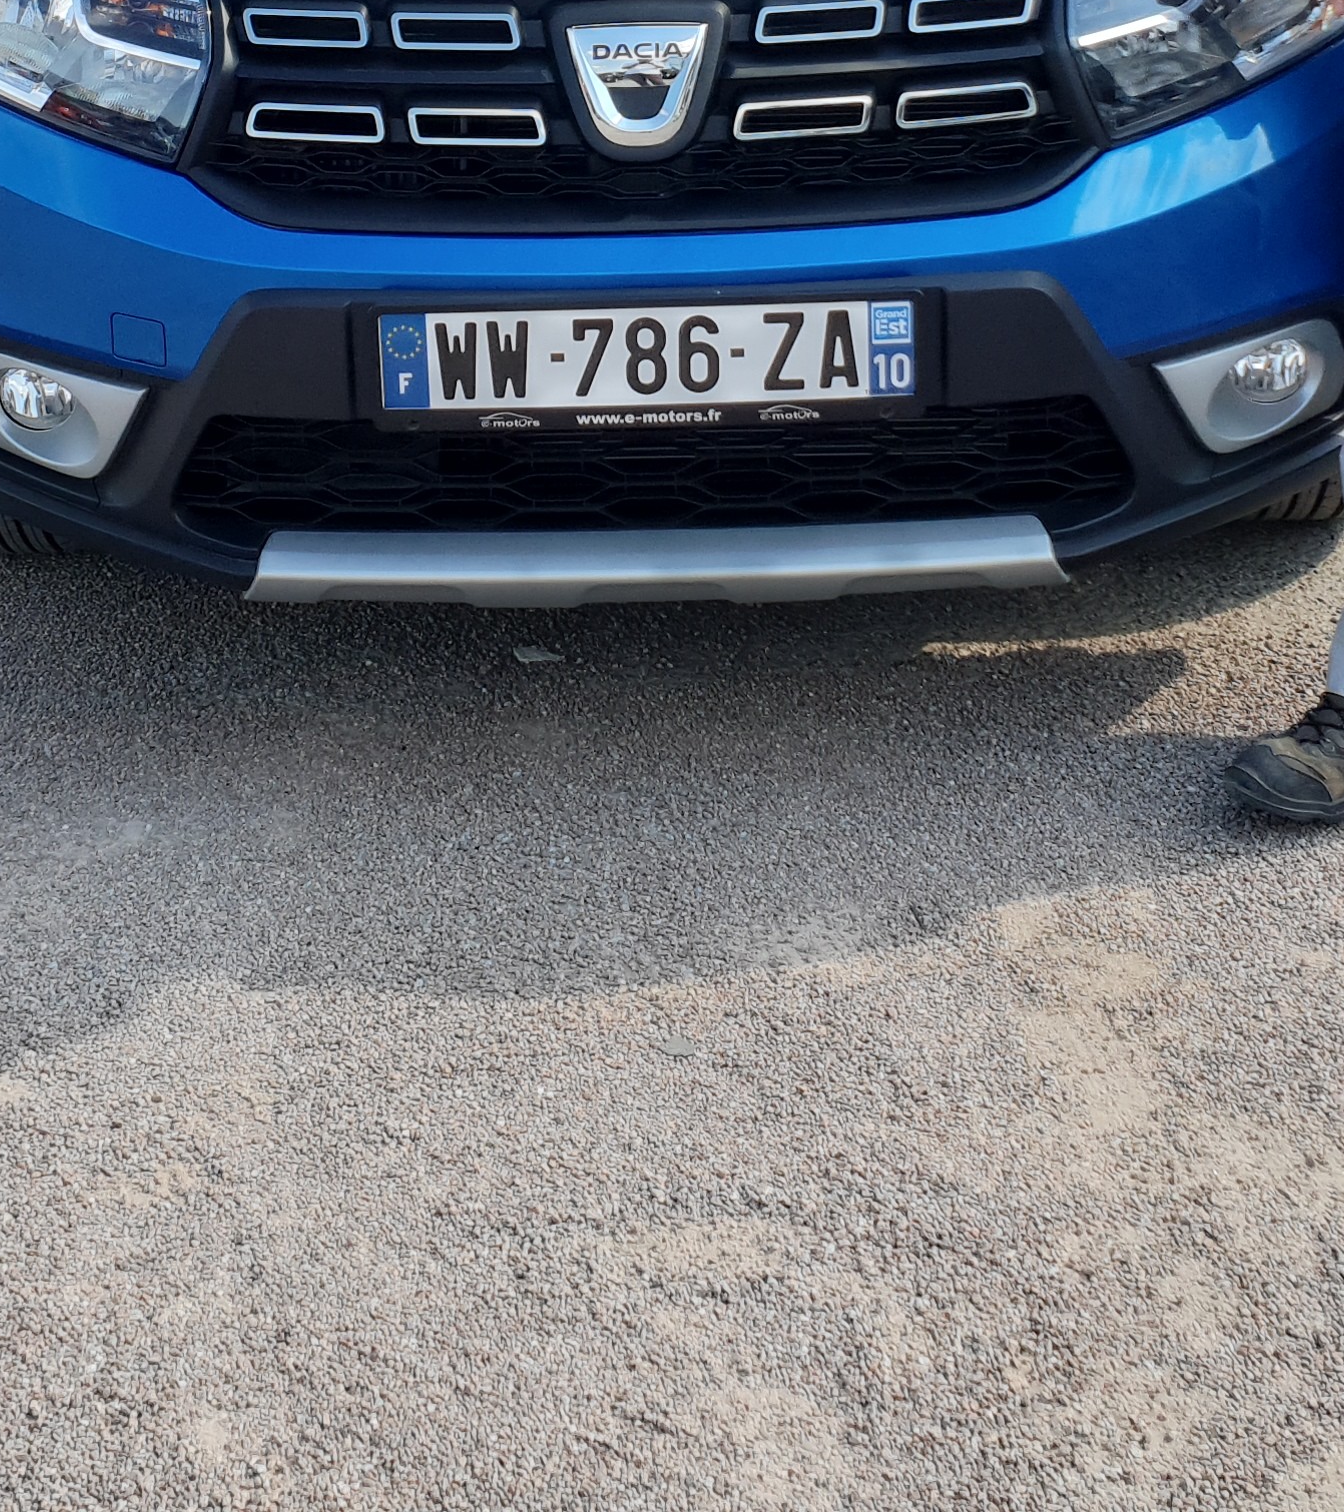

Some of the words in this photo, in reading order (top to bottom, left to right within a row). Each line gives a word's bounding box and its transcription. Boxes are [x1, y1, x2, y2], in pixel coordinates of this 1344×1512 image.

[592, 42, 683, 60] DACIA
[875, 308, 907, 319] Grand
[875, 318, 908, 335] Est
[434, 309, 860, 400] WW-786-ZA
[873, 352, 911, 390] 10
[398, 373, 413, 394] F
[575, 409, 722, 425] www.e-motors.fr
